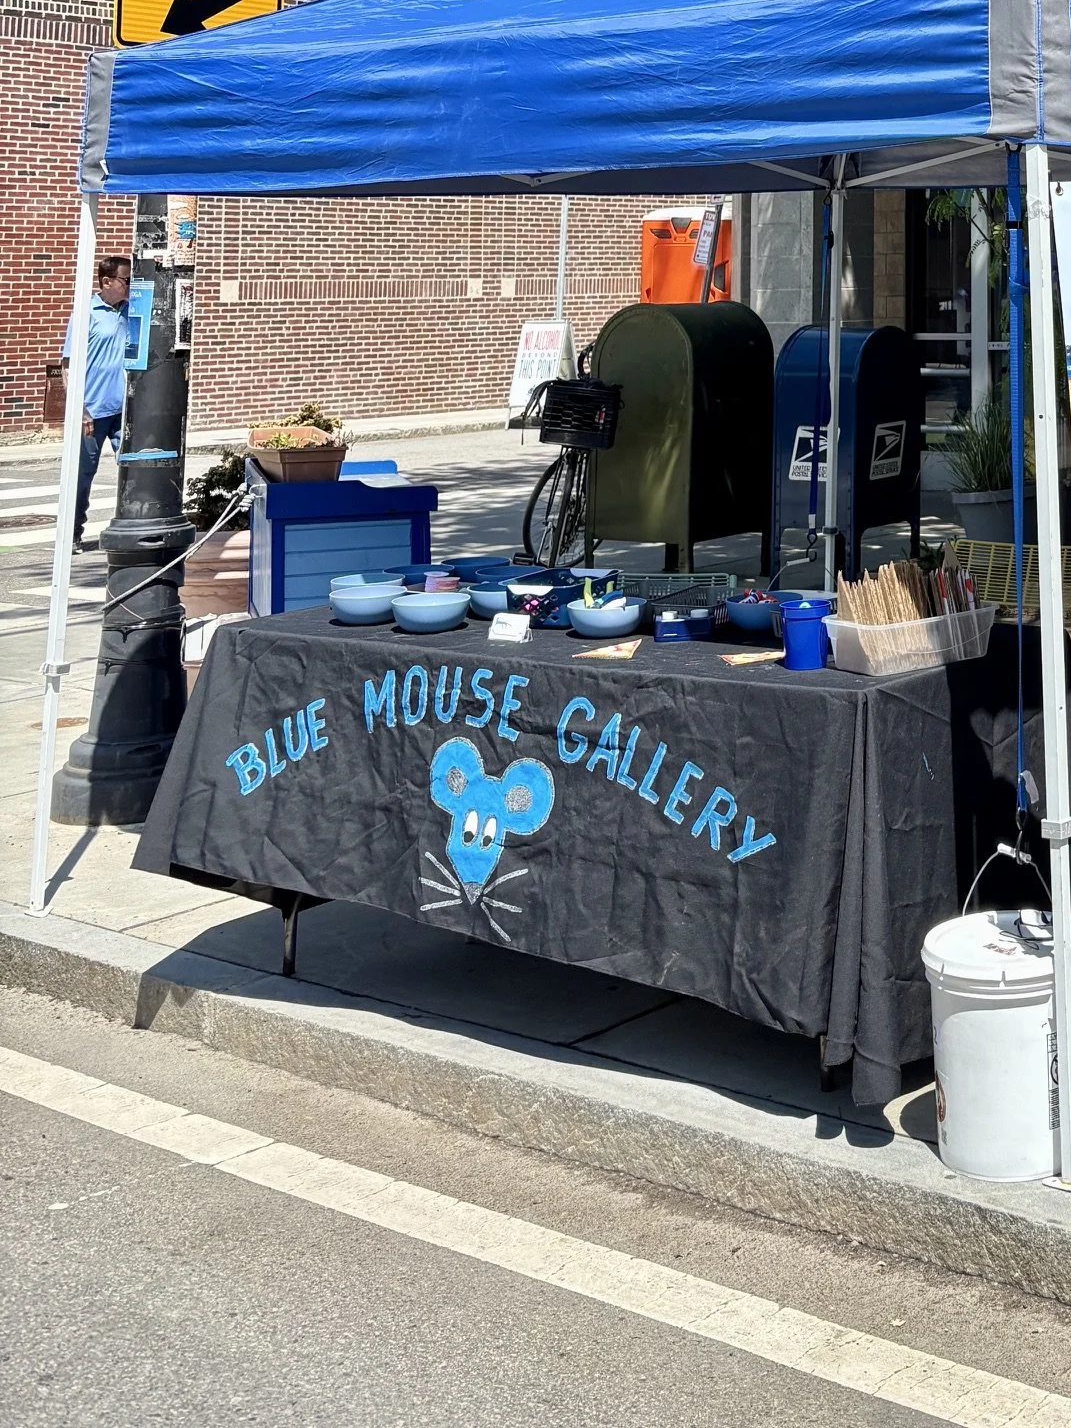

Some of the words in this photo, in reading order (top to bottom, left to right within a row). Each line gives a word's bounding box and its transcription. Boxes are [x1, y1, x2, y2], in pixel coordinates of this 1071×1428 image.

[226, 697, 329, 797] BLUE
[363, 664, 531, 743] MOUSE
[556, 695, 777, 863] GALLERY
